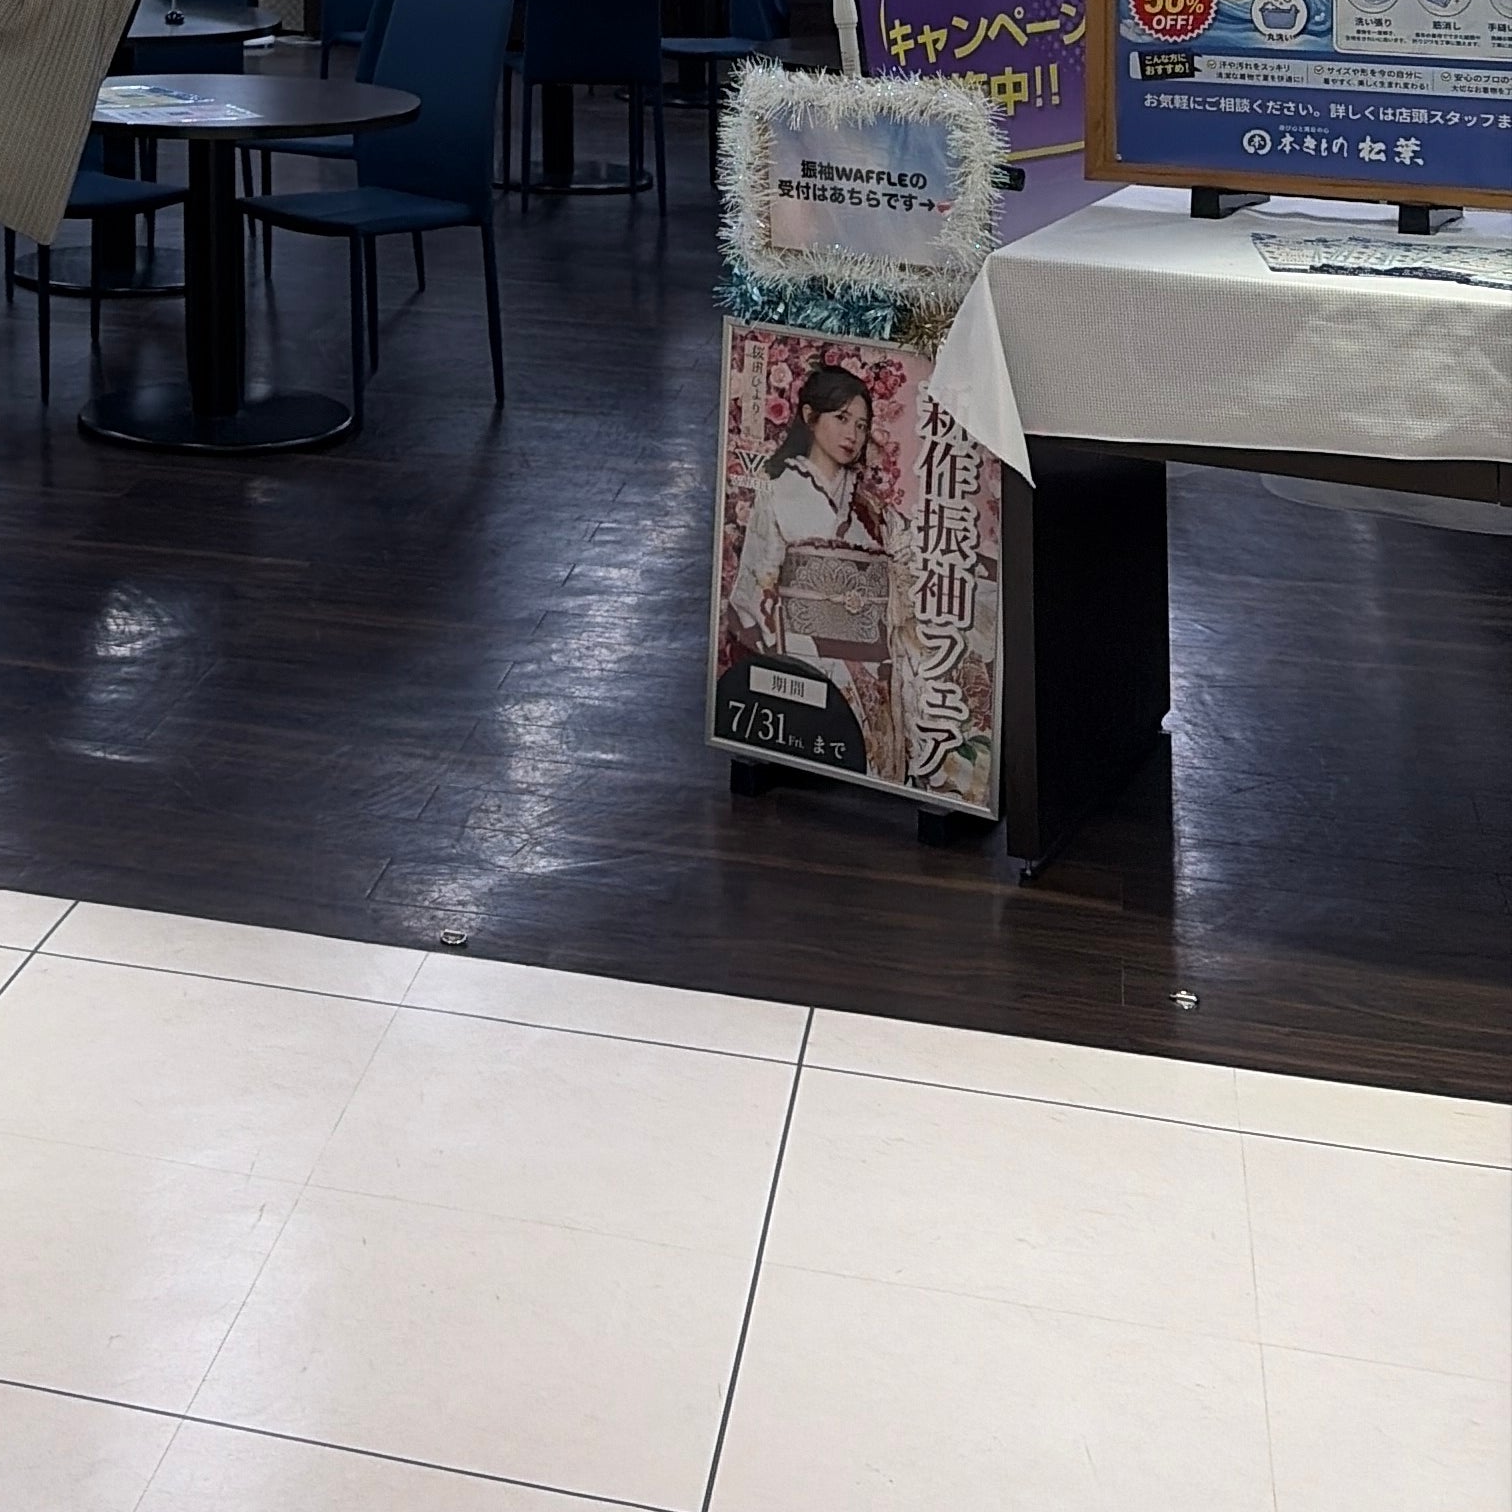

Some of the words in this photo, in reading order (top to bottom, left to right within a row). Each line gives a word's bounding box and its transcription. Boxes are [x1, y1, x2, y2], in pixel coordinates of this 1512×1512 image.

[889, 2, 1085, 66] キャンペーン
[1152, 15, 1194, 30] OFF!
[800, 159, 927, 190] 振袖WAFFLEの
[728, 700, 786, 745] 7/31
[813, 735, 847, 759] まで
